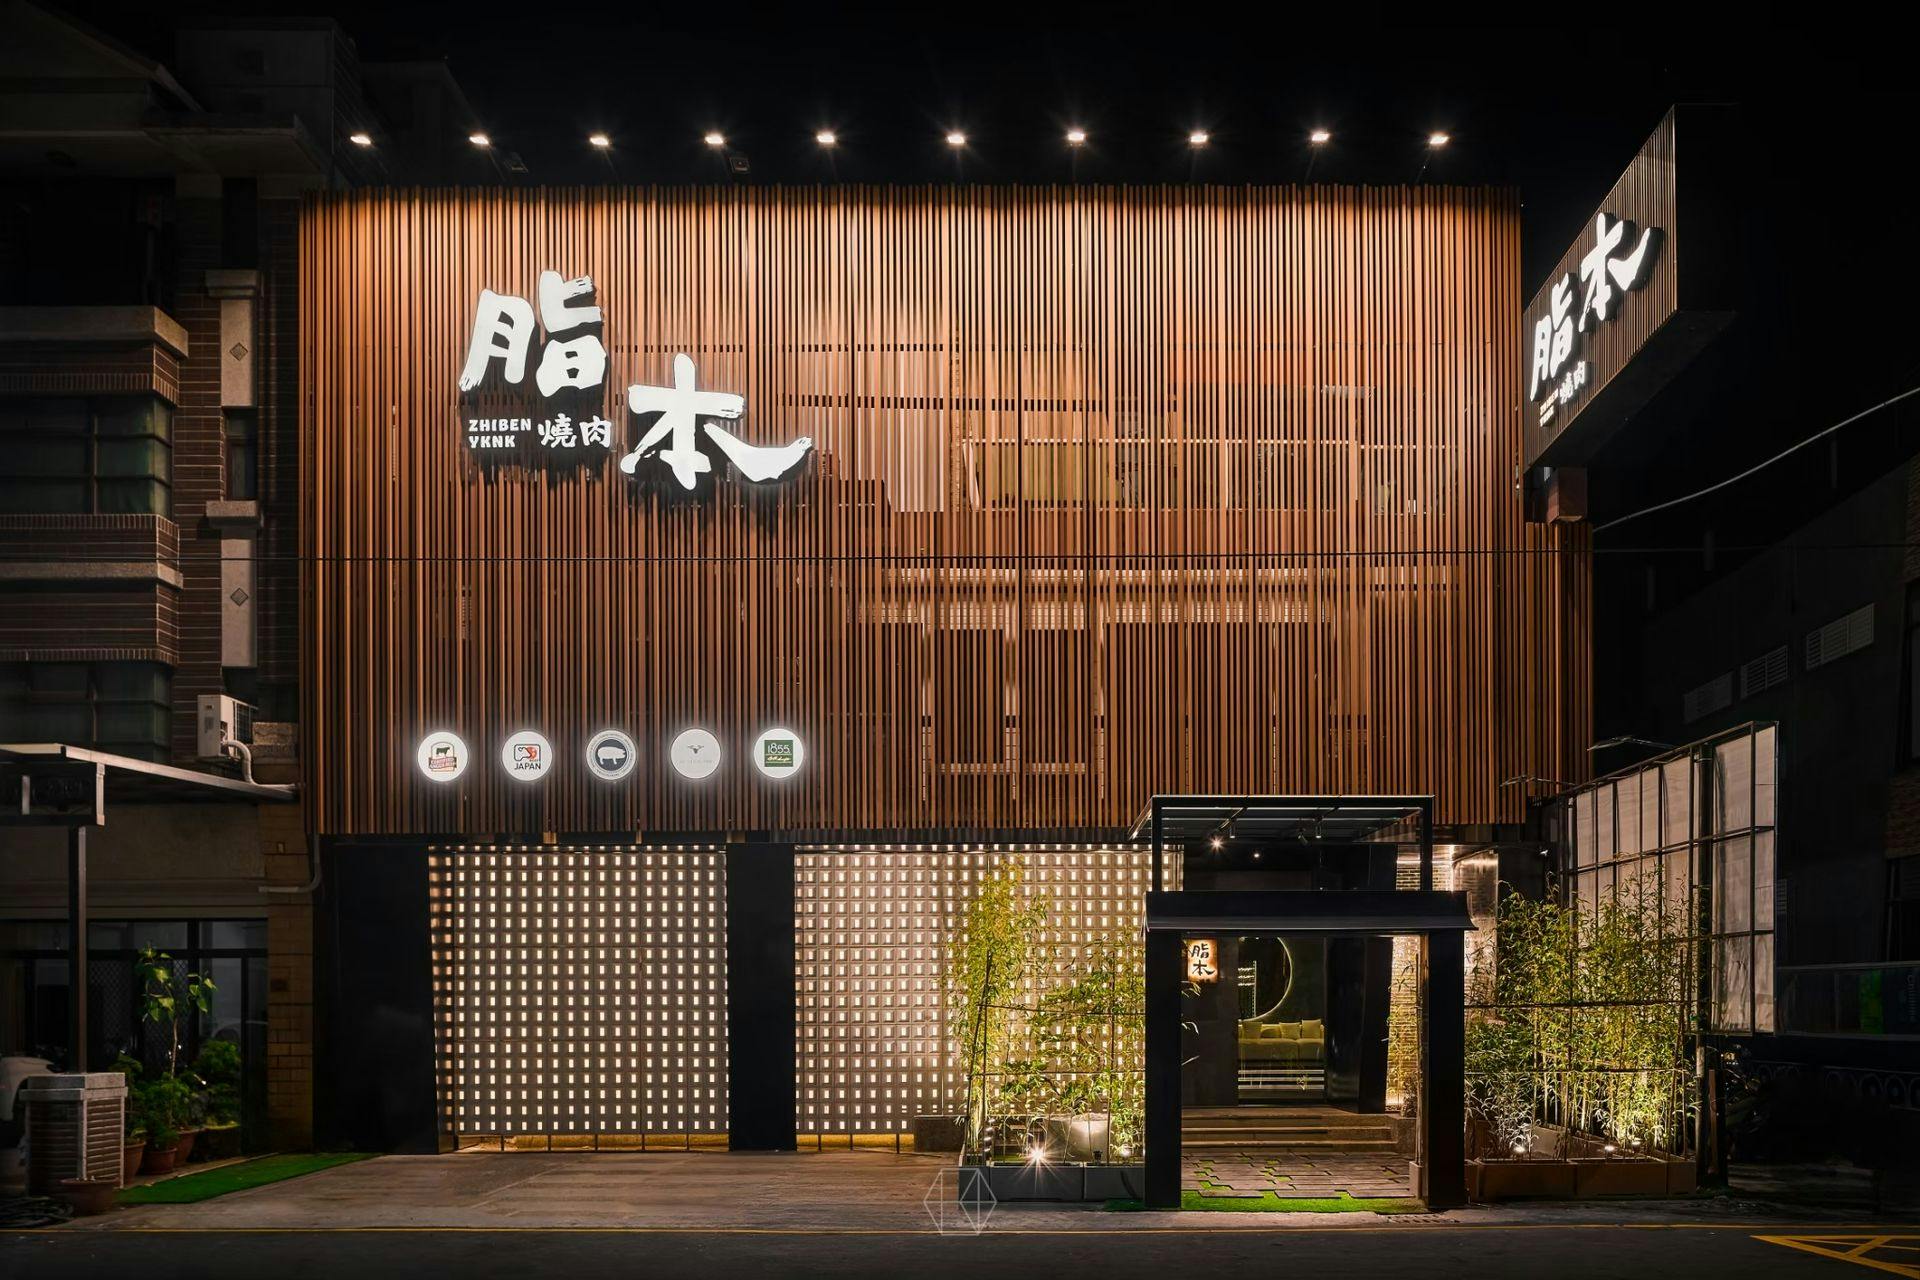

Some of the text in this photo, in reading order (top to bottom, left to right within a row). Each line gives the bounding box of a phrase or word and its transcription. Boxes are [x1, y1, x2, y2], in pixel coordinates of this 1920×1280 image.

[1530, 212, 1650, 402] 脂本
[459, 270, 812, 490] 脂本
[468, 419, 531, 431] ZHIBEN
[468, 435, 516, 448] YKNK
[537, 413, 612, 448] 燒肉
[768, 743, 790, 754] 1855
[1191, 943, 1216, 976] 脂本
